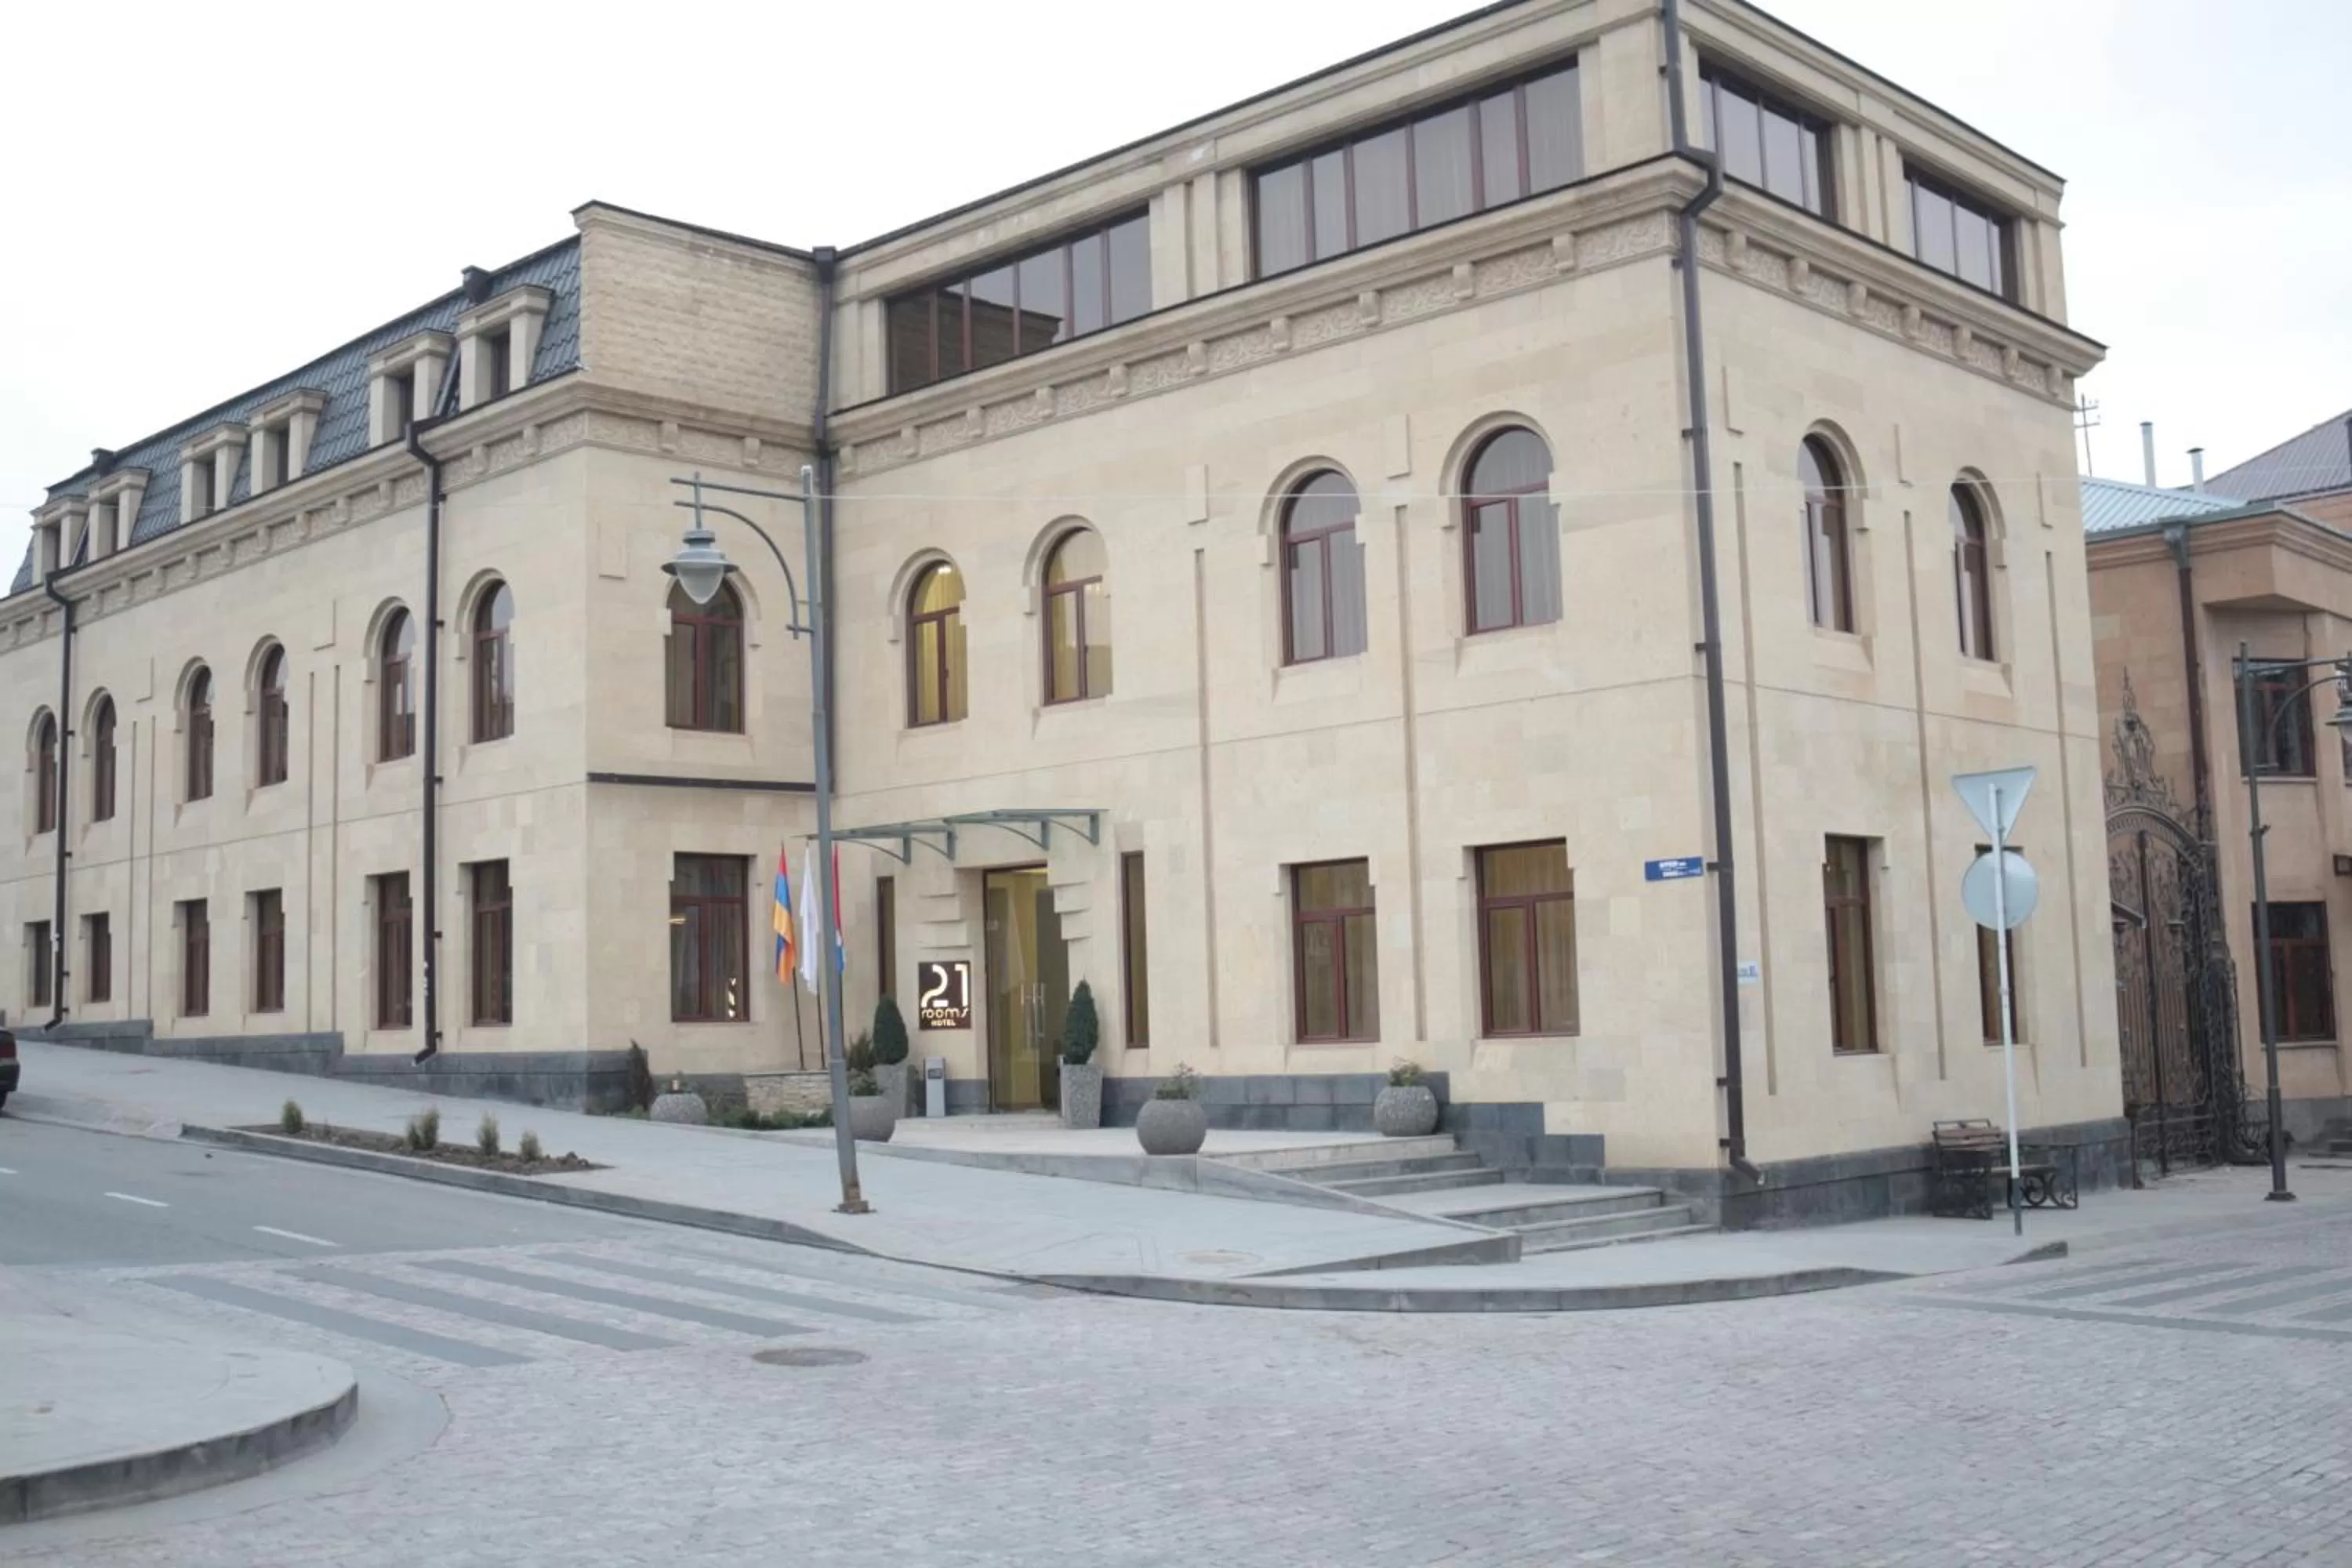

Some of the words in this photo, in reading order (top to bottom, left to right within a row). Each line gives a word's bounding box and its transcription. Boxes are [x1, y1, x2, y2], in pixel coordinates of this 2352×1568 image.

[920, 964, 969, 1007] 21
[921, 1007, 969, 1019] rooms
[931, 1018, 956, 1027] HOTEL
